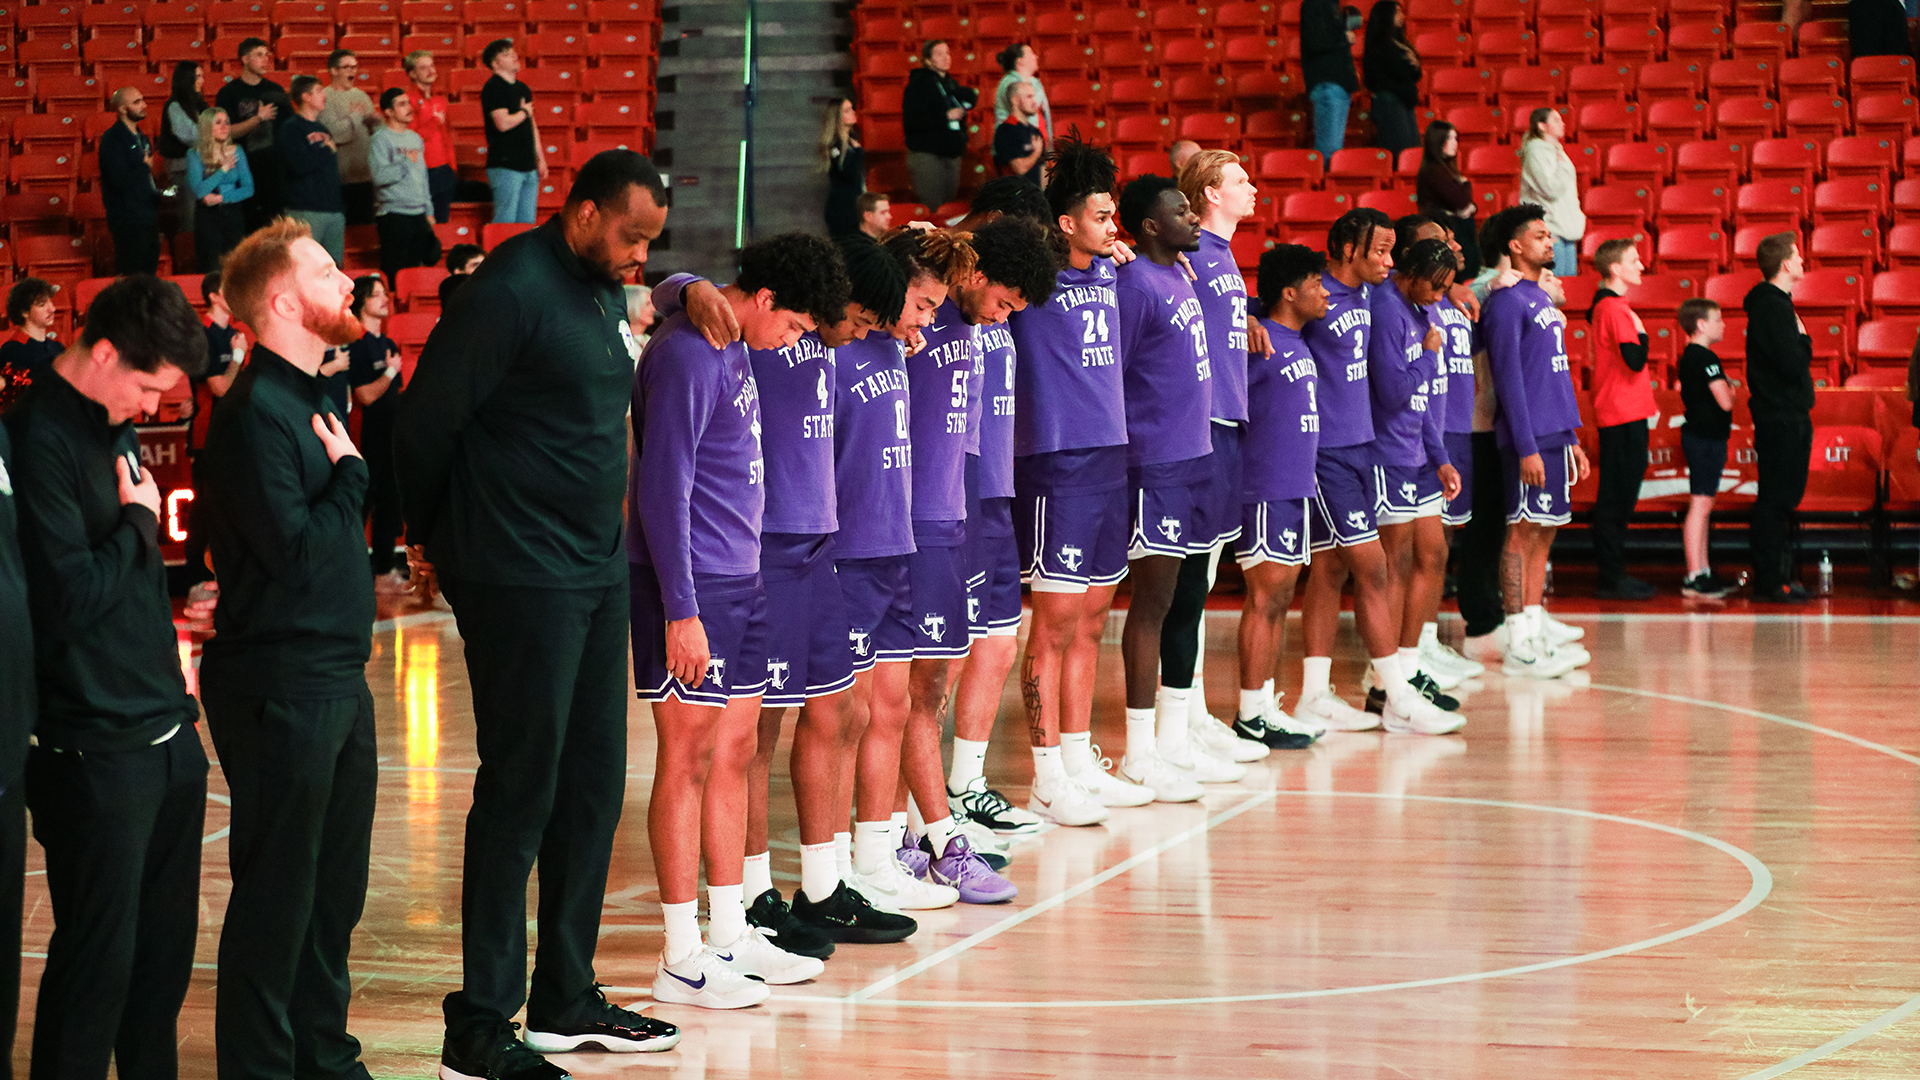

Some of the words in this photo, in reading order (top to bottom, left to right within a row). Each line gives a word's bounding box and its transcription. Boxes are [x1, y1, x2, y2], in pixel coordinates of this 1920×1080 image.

[1055, 286, 1116, 312] TARLETON
[1231, 296, 1247, 329] 25
[1082, 309, 1109, 343] 24
[1451, 327, 1471, 355] 30
[1082, 346, 1115, 367] STATE
[1354, 329, 1364, 359] 2
[817, 368, 828, 408] 4
[895, 399, 908, 439] 0
[140, 444, 176, 466] AH
